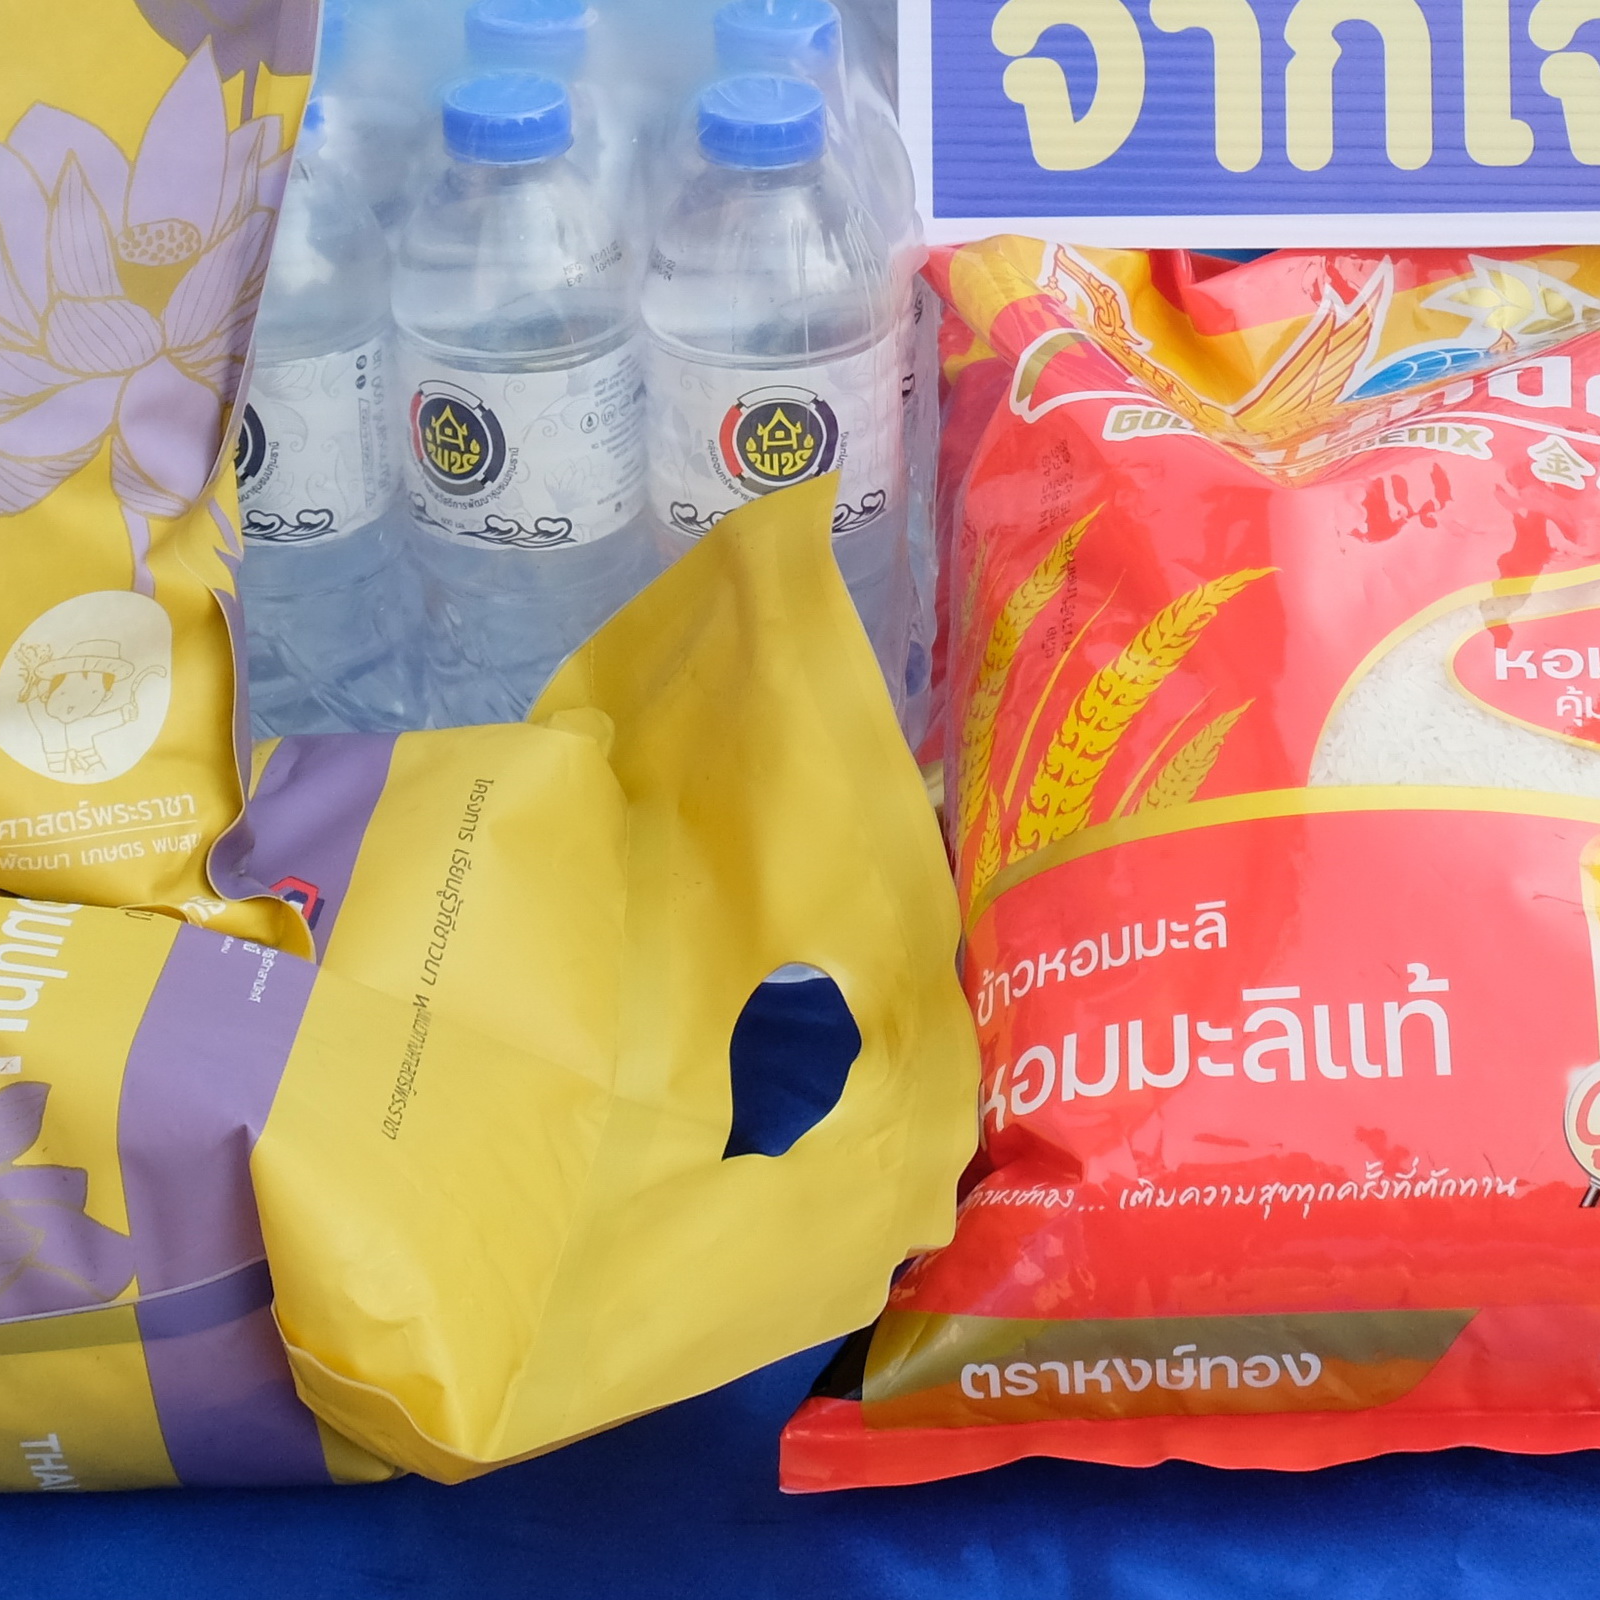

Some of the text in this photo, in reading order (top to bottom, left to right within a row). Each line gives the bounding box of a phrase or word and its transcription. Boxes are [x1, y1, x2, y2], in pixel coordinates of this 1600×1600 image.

[1110, 408, 1191, 434] GOL
[458, 777, 495, 843] โครงการ
[81, 840, 145, 866] เกษตร
[977, 900, 1228, 1028] ข้าวหอมมะลิ
[978, 961, 1451, 1151] หอมมะลิแท้
[959, 1340, 1323, 1401] ตราหงษ์ทอง
